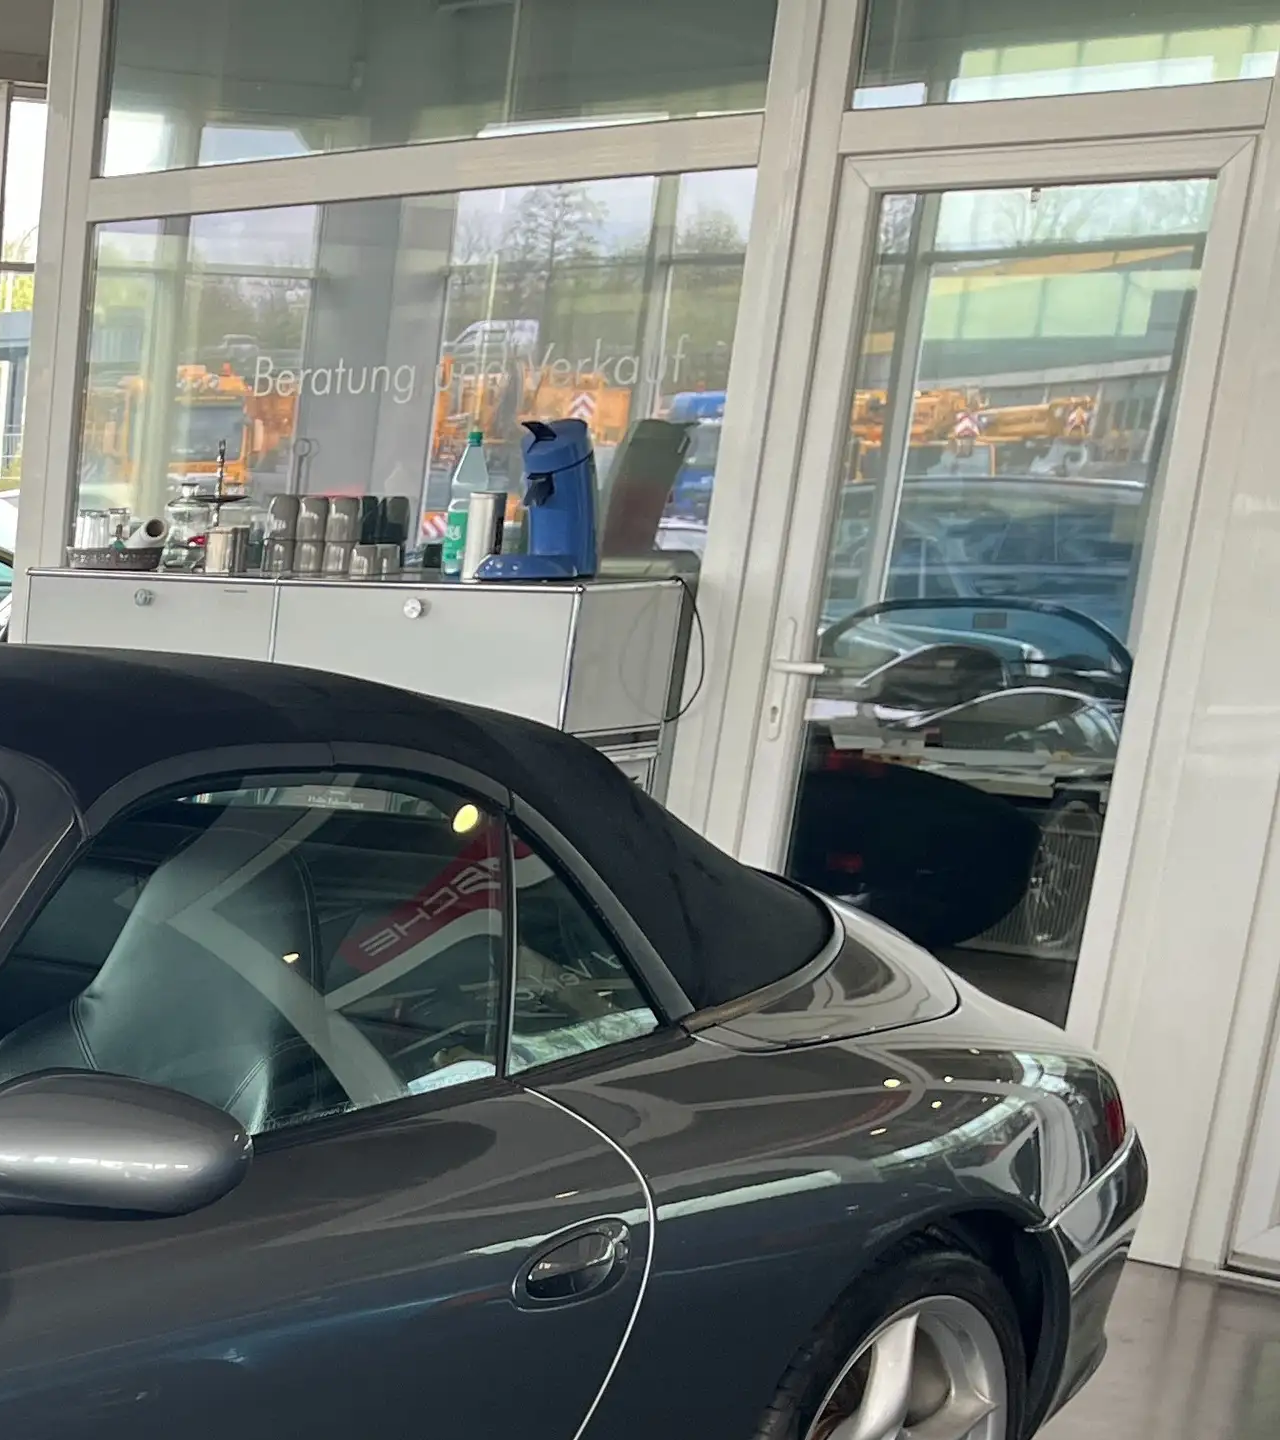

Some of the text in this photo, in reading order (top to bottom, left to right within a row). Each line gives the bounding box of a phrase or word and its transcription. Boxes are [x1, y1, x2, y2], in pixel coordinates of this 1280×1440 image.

[252, 334, 690, 403] Beratung und Verkauf
